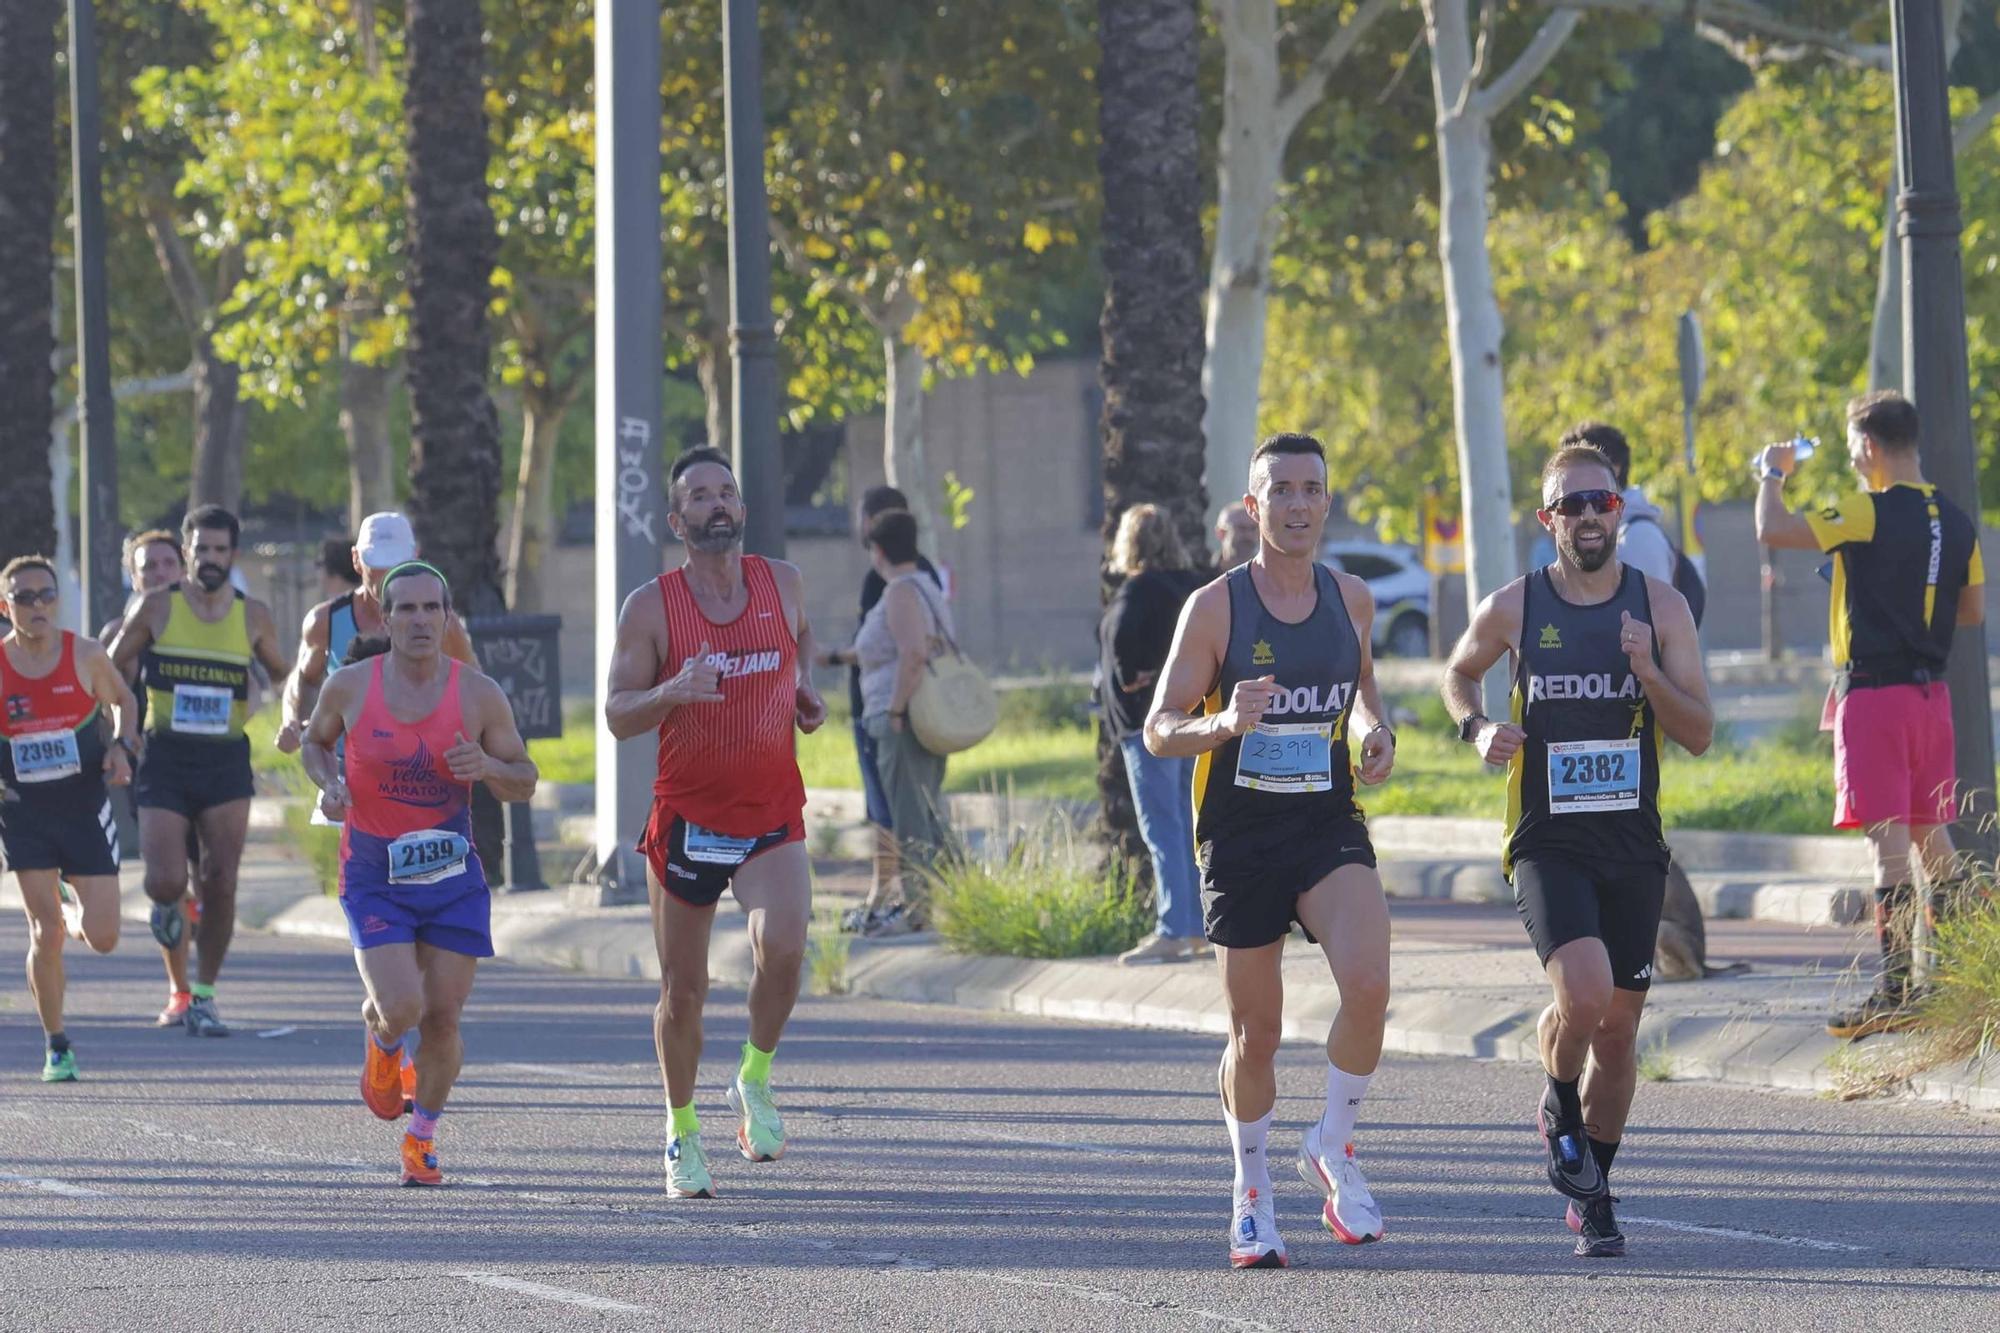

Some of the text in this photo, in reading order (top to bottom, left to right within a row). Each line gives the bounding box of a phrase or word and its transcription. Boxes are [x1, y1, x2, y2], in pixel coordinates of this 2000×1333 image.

[19, 740, 66, 763] 2396
[1251, 740, 1312, 760] 2399
[1562, 754, 1625, 784] 2382
[402, 838, 454, 868] 2139
